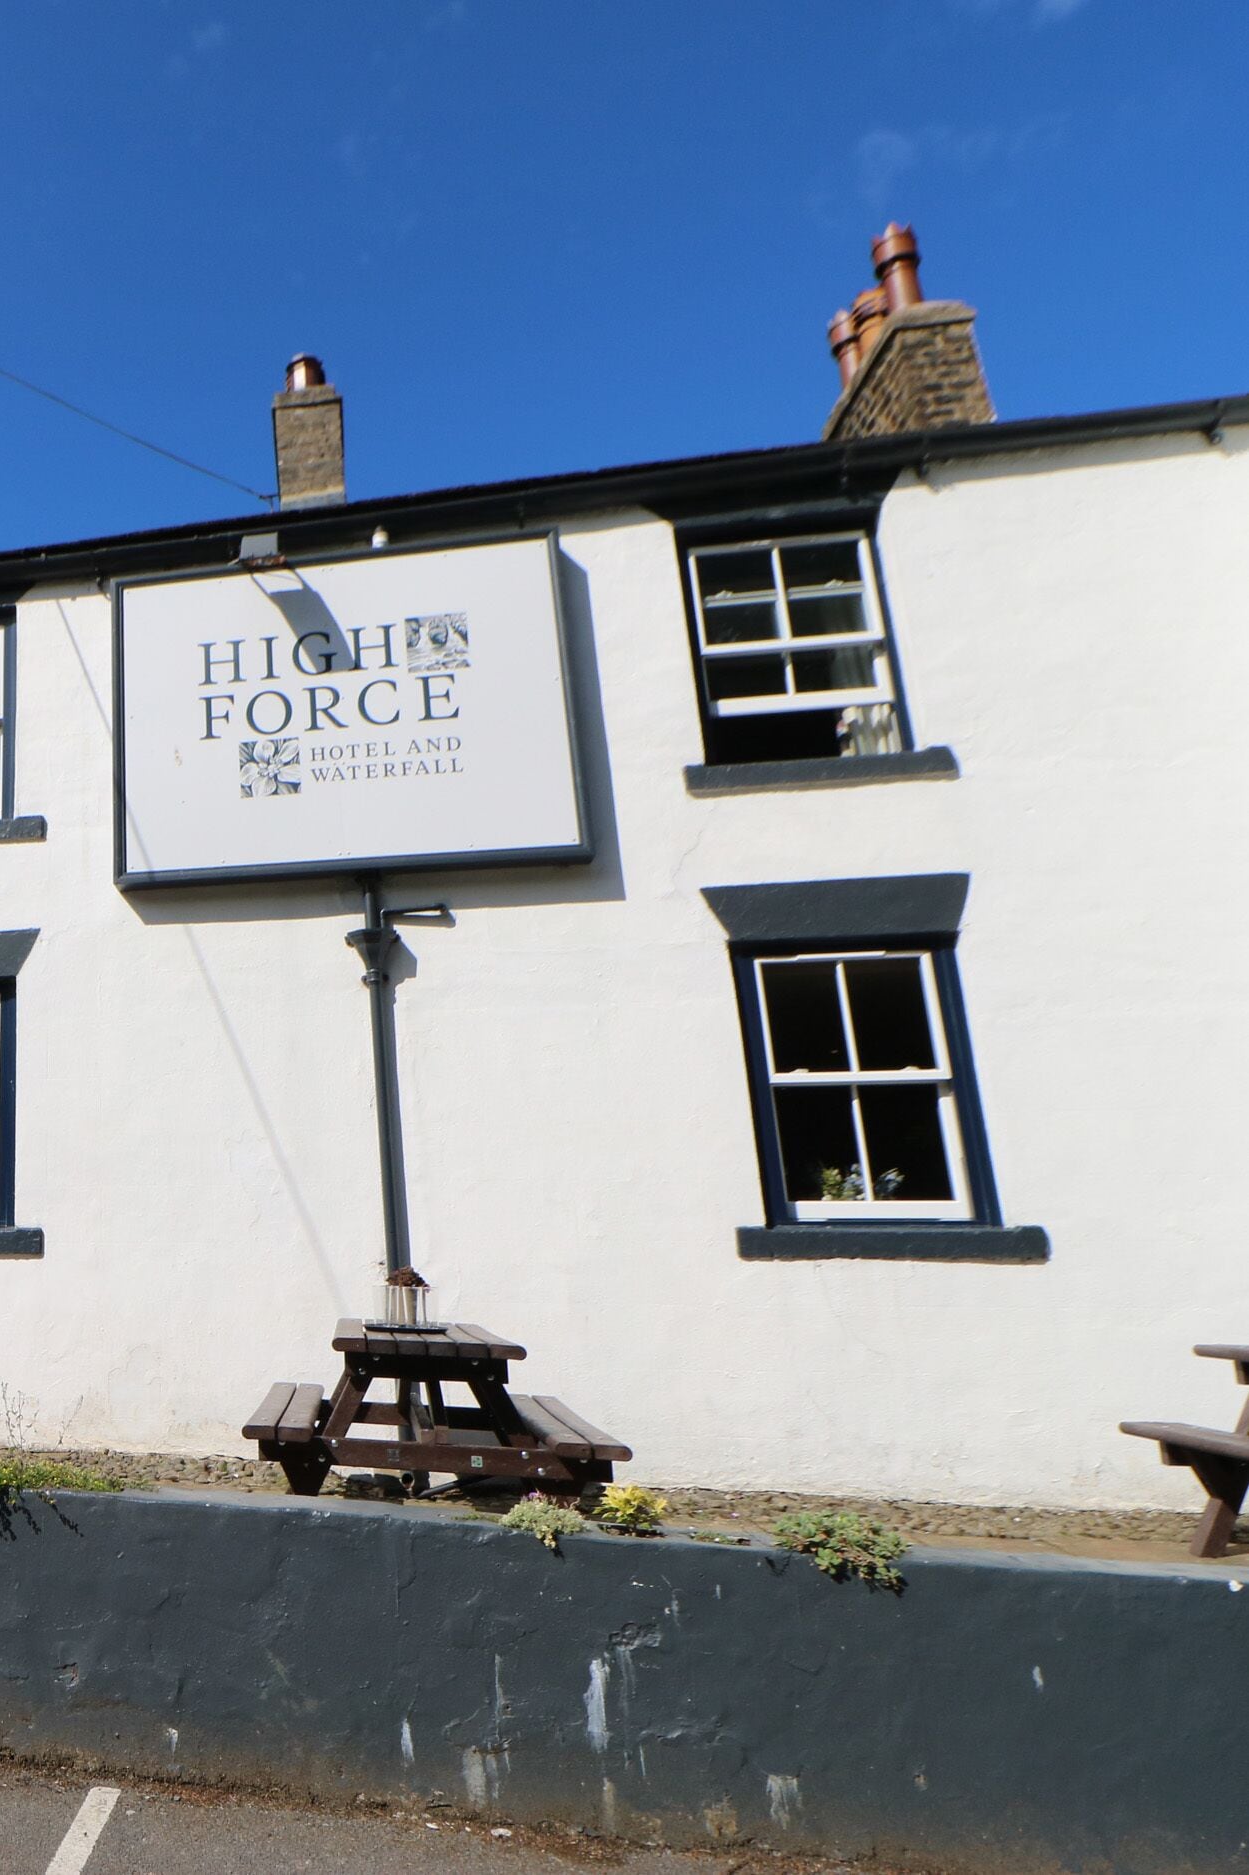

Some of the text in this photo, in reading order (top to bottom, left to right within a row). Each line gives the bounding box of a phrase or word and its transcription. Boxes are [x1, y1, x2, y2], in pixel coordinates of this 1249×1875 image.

[198, 623, 400, 686] HIGH
[199, 673, 460, 740] FORCE
[310, 758, 464, 783] WATERFALL
[311, 736, 462, 762] HOTEL AND
